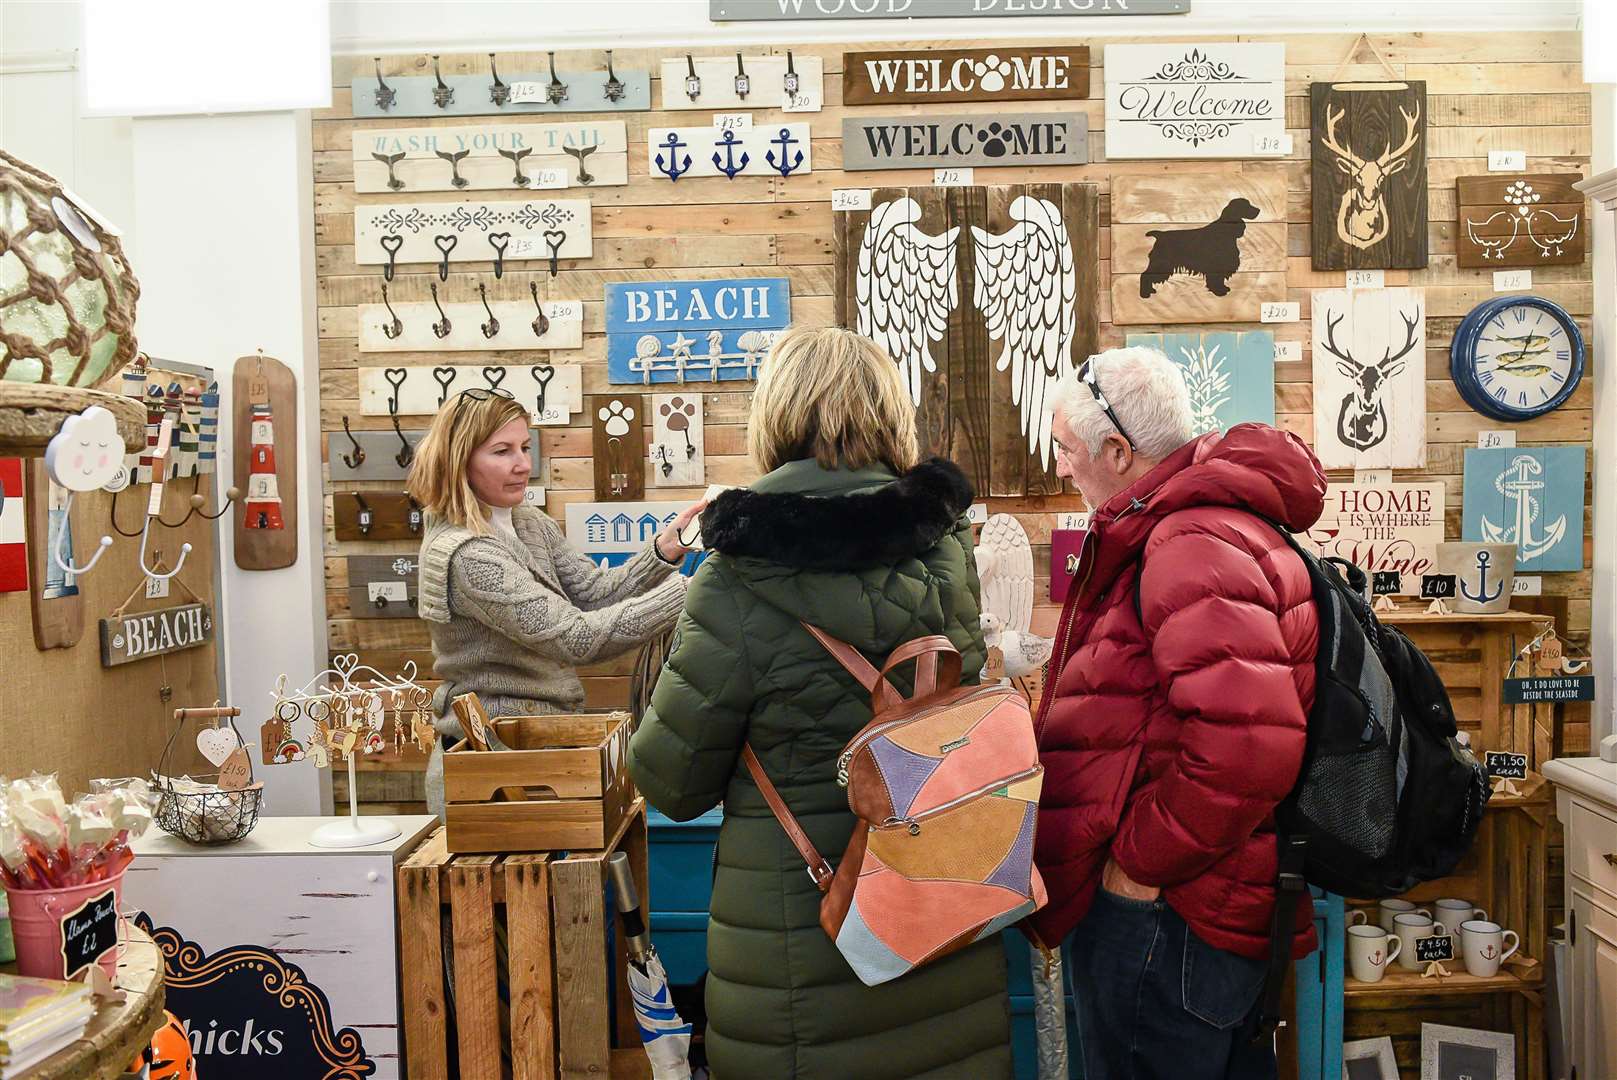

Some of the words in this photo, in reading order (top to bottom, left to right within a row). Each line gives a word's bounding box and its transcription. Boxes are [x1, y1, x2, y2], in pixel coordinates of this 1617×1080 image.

[1119, 85, 1273, 119] Welcome
[721, 116, 743, 131] £25
[374, 135, 438, 152] WASH
[456, 131, 524, 150] YOUR
[545, 129, 606, 148] TAIL
[839, 193, 860, 206] £45
[551, 304, 572, 318] £30
[624, 287, 770, 323] BEACH
[1268, 305, 1288, 318] £20
[1485, 432, 1502, 448] £12
[1339, 490, 1432, 513] HOME
[1065, 514, 1085, 530] £10
[1349, 513, 1364, 527] IS
[1369, 513, 1431, 527] WHERE
[1362, 527, 1396, 540] THE
[1335, 539, 1433, 576] Wine
[1376, 580, 1397, 592] each
[1426, 581, 1448, 594] £10
[1511, 579, 1529, 593] £10
[124, 607, 204, 657] BEACH
[1548, 680, 1563, 689] LOVE
[1564, 679, 1572, 688] TO
[1523, 691, 1542, 700] BESIDE
[1544, 691, 1553, 699] THE
[1555, 690, 1579, 699] SEASIDE
[1496, 767, 1521, 776] each
[1418, 938, 1448, 951] £4.50
[1424, 948, 1447, 960] each
[183, 1018, 284, 1056] hicks
